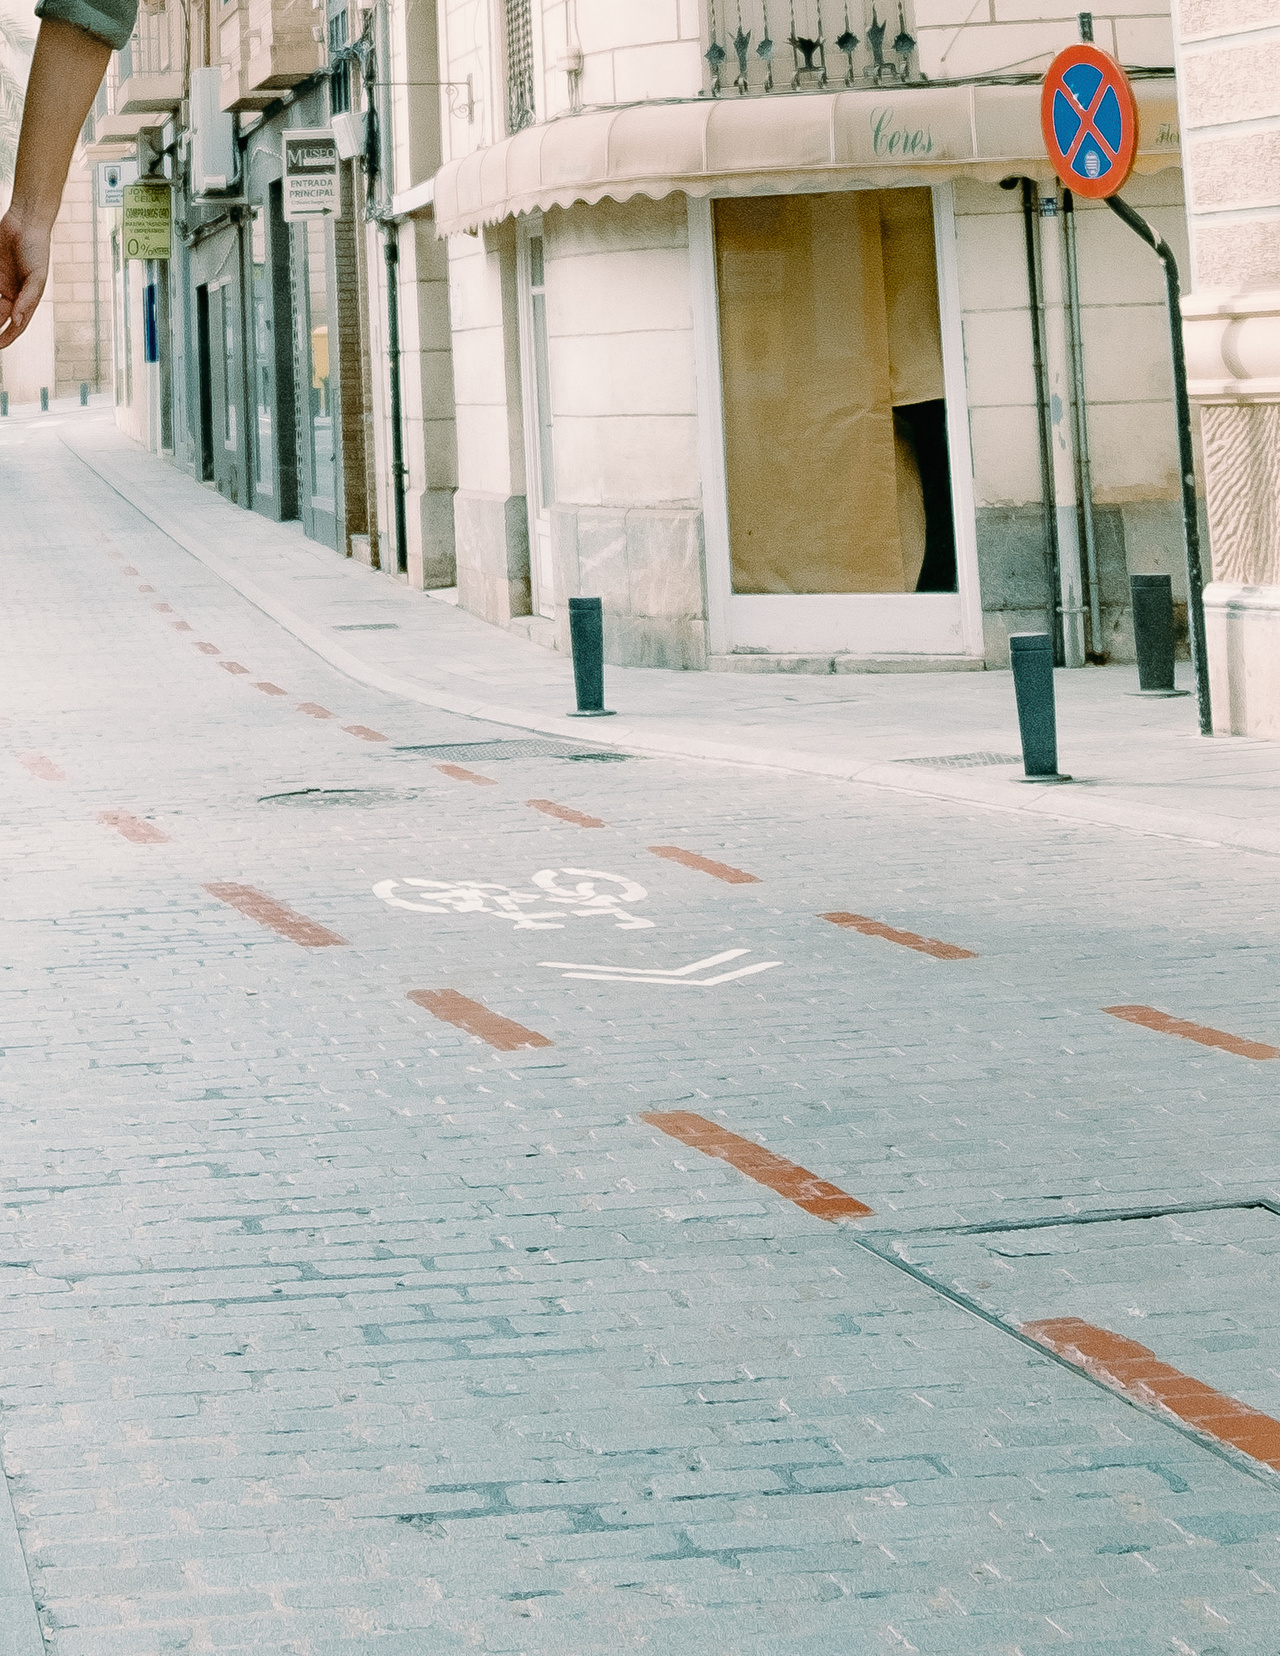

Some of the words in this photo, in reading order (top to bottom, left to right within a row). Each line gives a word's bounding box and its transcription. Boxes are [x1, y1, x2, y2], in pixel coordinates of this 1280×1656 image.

[870, 106, 933, 157] Ceres
[287, 147, 336, 167] MUSEO
[290, 179, 333, 188] ENTRADA
[289, 189, 335, 198] PRINCIPAL
